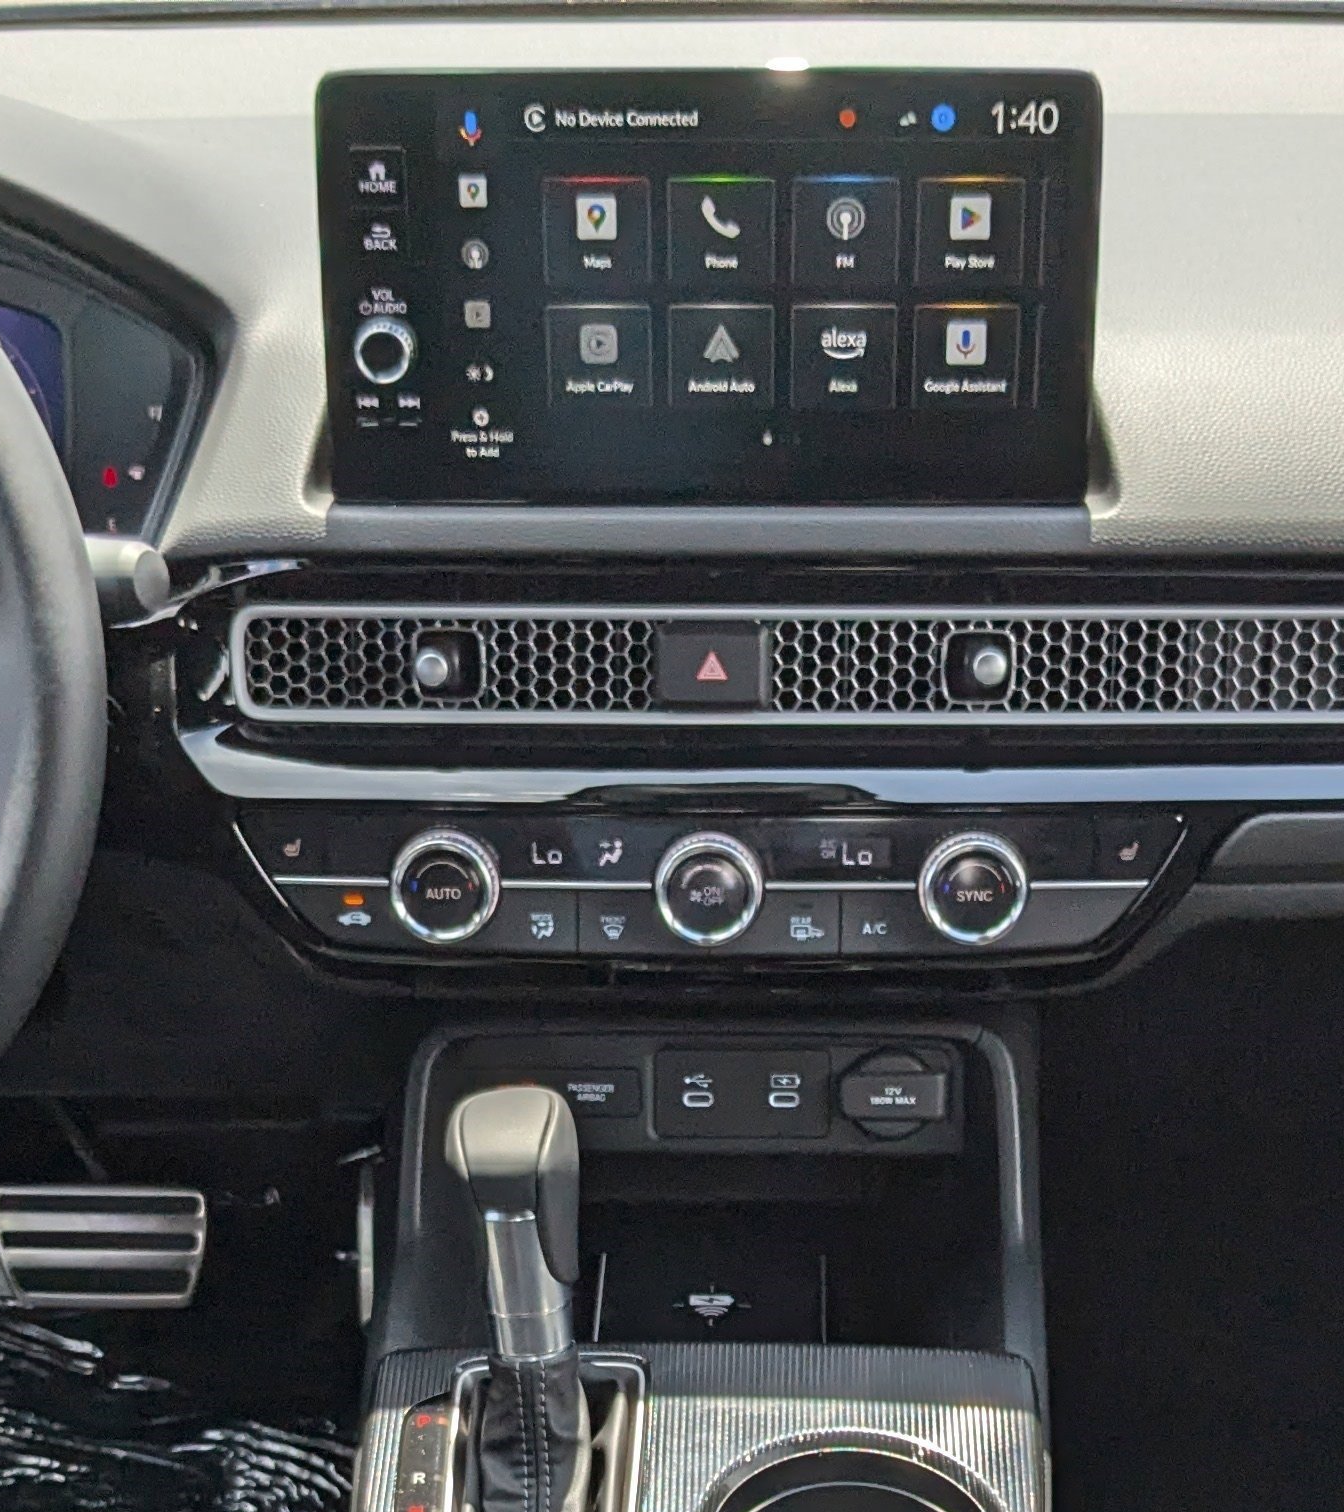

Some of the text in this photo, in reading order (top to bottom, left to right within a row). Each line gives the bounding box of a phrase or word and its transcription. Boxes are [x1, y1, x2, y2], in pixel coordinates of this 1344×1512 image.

[556, 109, 699, 127] No Device Connected
[992, 100, 1059, 135] 1:40
[358, 181, 397, 194] HOME
[363, 237, 397, 251] BACK
[583, 255, 612, 271] Maps
[705, 255, 738, 269] Phone
[836, 254, 855, 268] FM
[944, 254, 995, 271] Play Store
[370, 287, 395, 301] VOL
[373, 303, 407, 314] AUDIO
[821, 326, 867, 348] alexa
[566, 380, 634, 394] Apple CarPlay
[688, 379, 755, 393] Android Auto
[828, 379, 858, 393] Alexa
[925, 379, 1007, 394] Google Assistant
[532, 841, 563, 864] Lo
[842, 841, 873, 865] Lo
[426, 888, 462, 900] AUTO
[957, 890, 993, 902] SYNC
[862, 923, 887, 935] A/C
[884, 1087, 903, 1095] 12V
[413, 1472, 426, 1485] R
